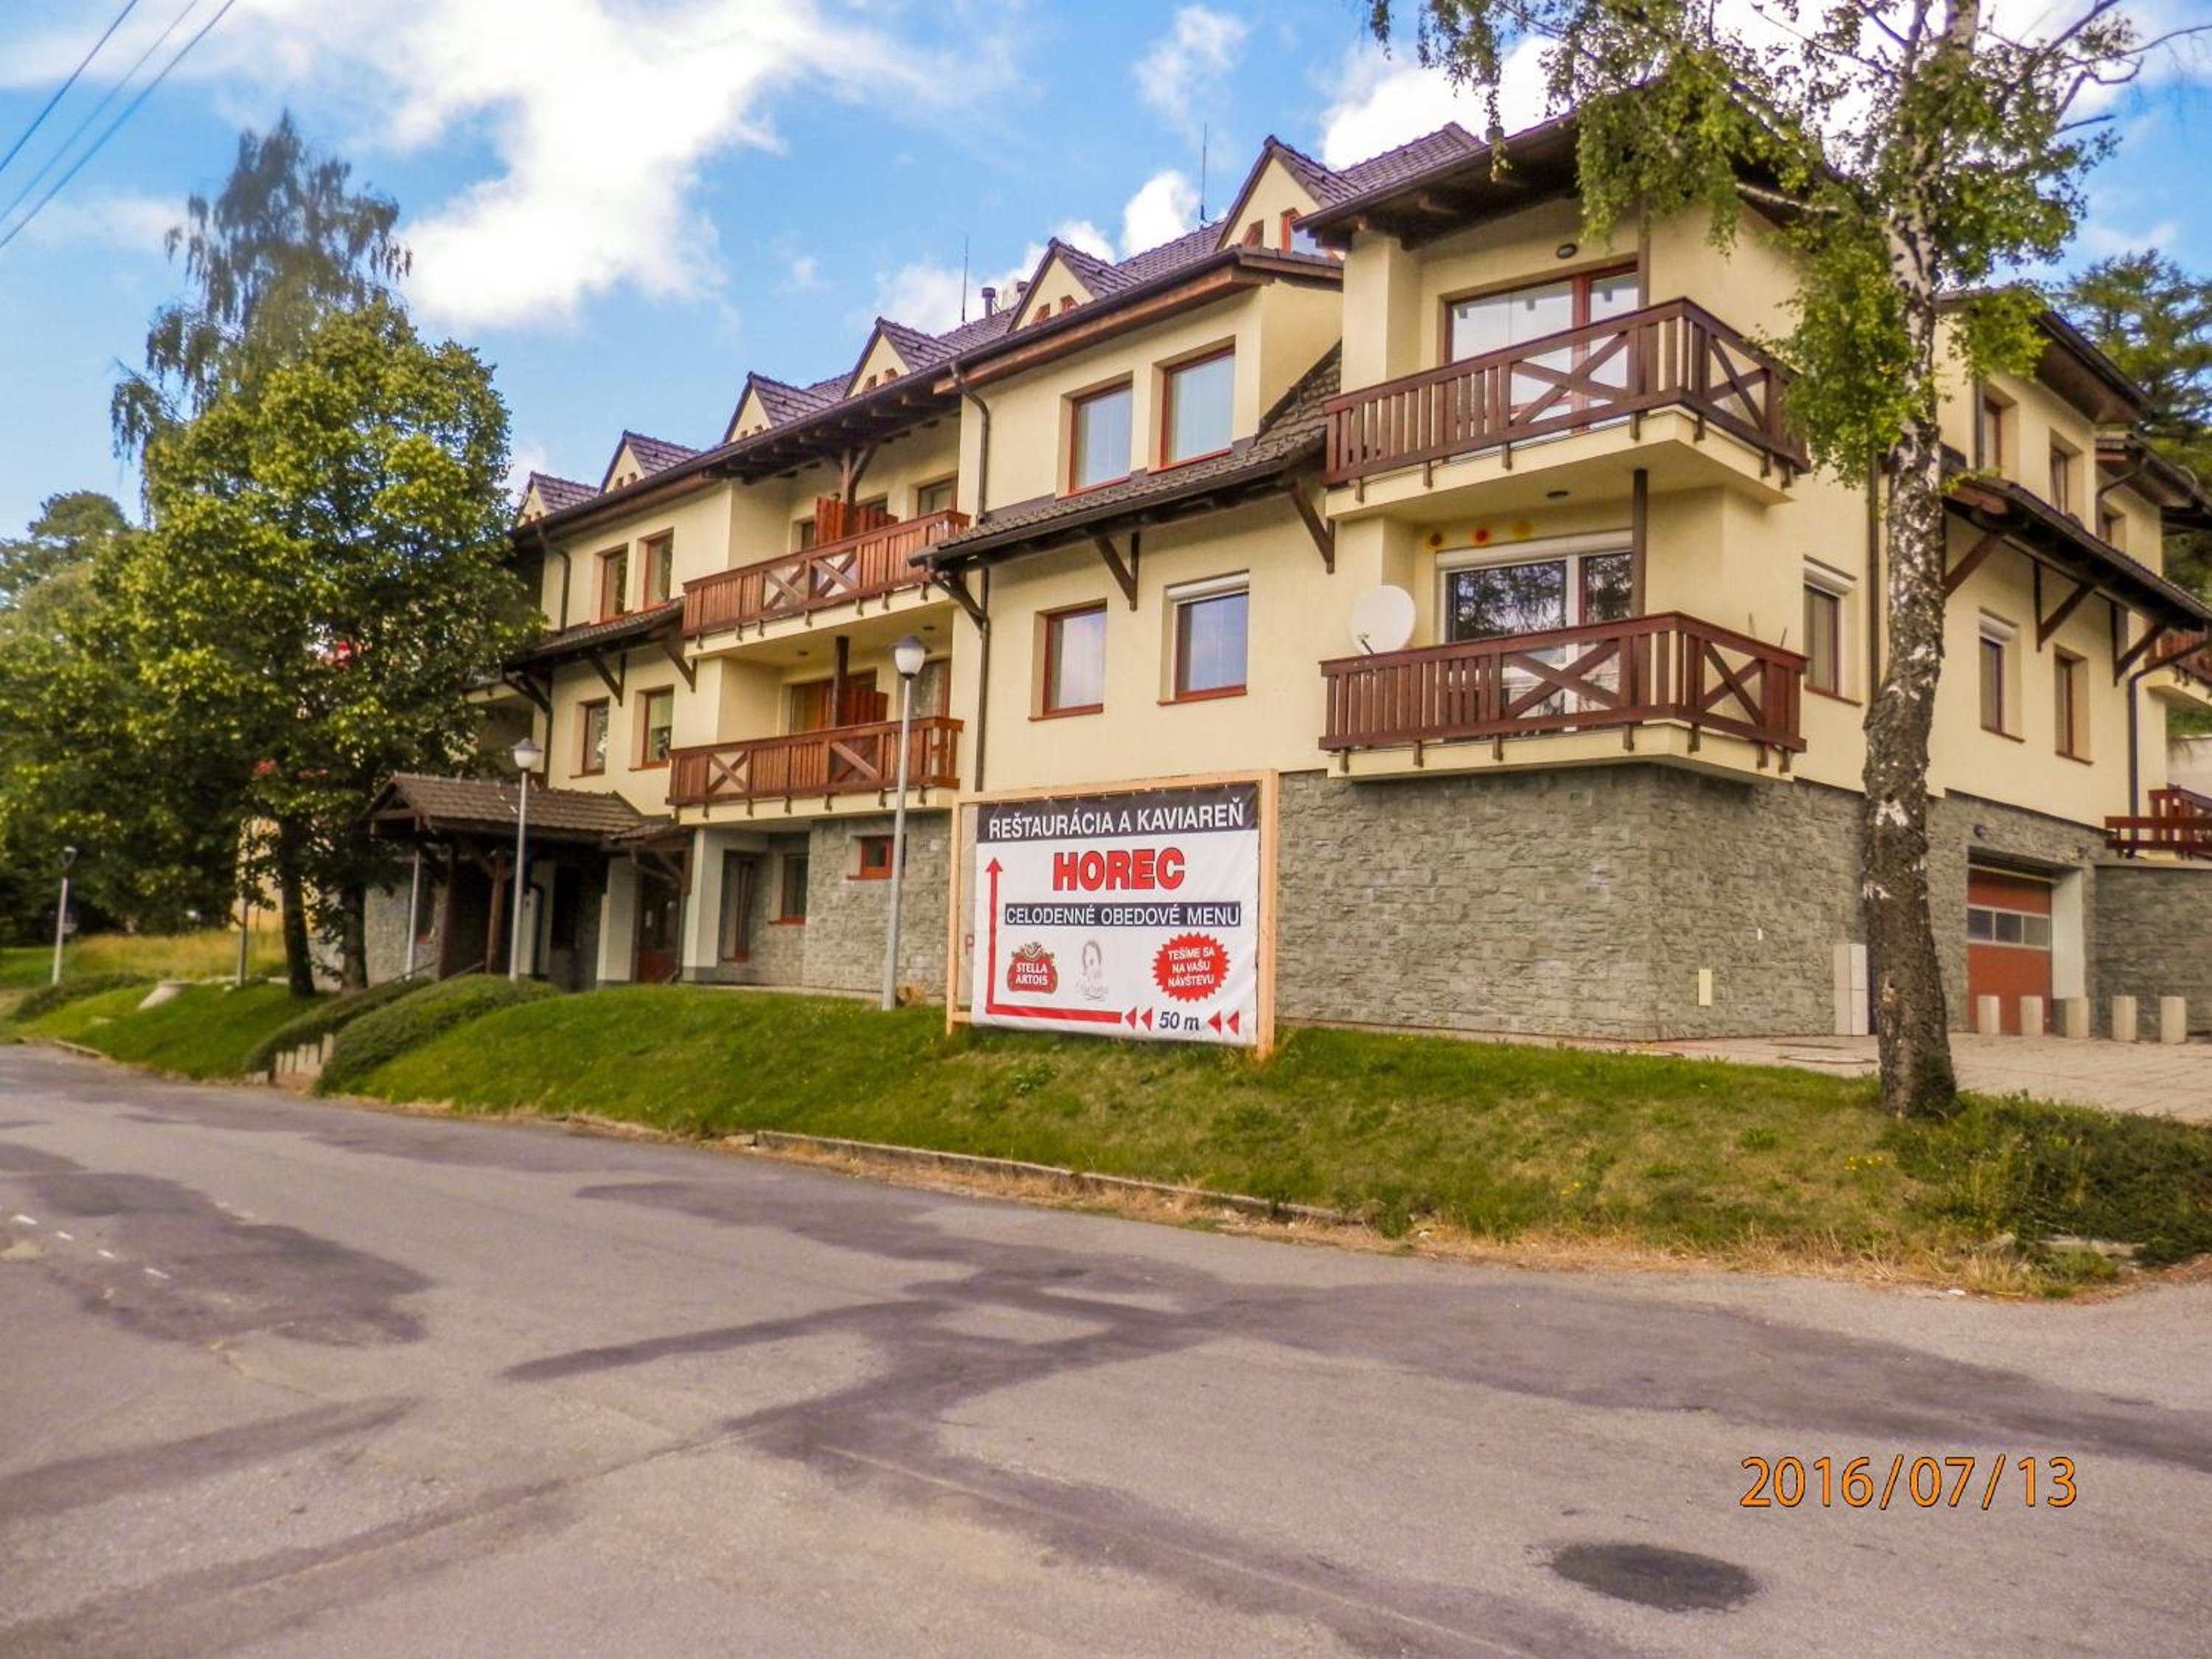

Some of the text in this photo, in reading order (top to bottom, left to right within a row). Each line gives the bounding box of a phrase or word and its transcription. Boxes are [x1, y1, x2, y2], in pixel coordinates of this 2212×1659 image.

[989, 796, 1244, 840] REŠTAURÁCIA A KAVIAREŇ
[1052, 846, 1186, 891] HOREC
[1006, 903, 1240, 925] CELODENNÉ OBEDOVÉ MENU
[1203, 946, 1216, 958] SA
[1016, 961, 1048, 974] STELLA
[1172, 959, 1211, 974] NA VAŠU
[1015, 973, 1048, 987] ARTOIS
[1158, 1011, 1200, 1032] 50 m
